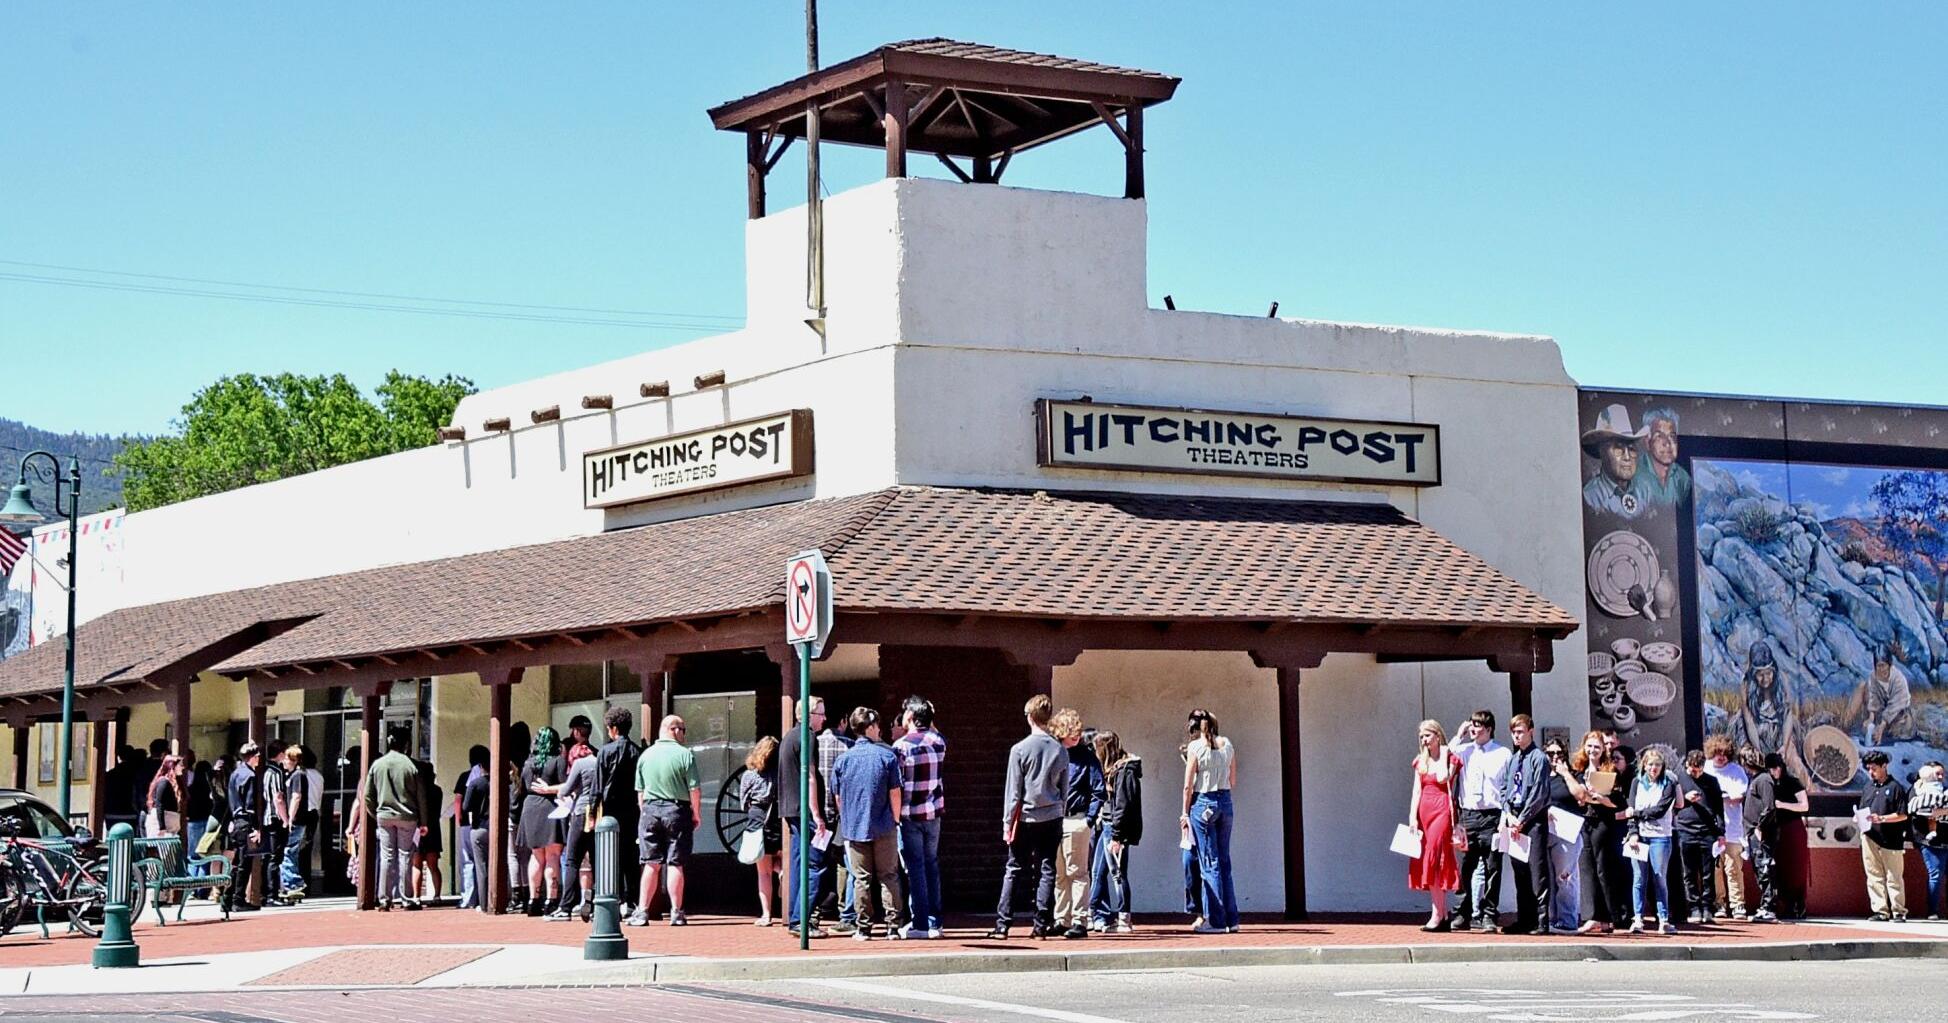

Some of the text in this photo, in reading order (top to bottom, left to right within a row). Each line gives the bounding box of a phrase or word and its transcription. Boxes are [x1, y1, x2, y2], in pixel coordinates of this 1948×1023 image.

[592, 421, 786, 498] HITCHING POST
[1063, 410, 1425, 474] HITCHING POST
[1187, 447, 1309, 470] THEATERS
[652, 464, 718, 488] THEATERS
